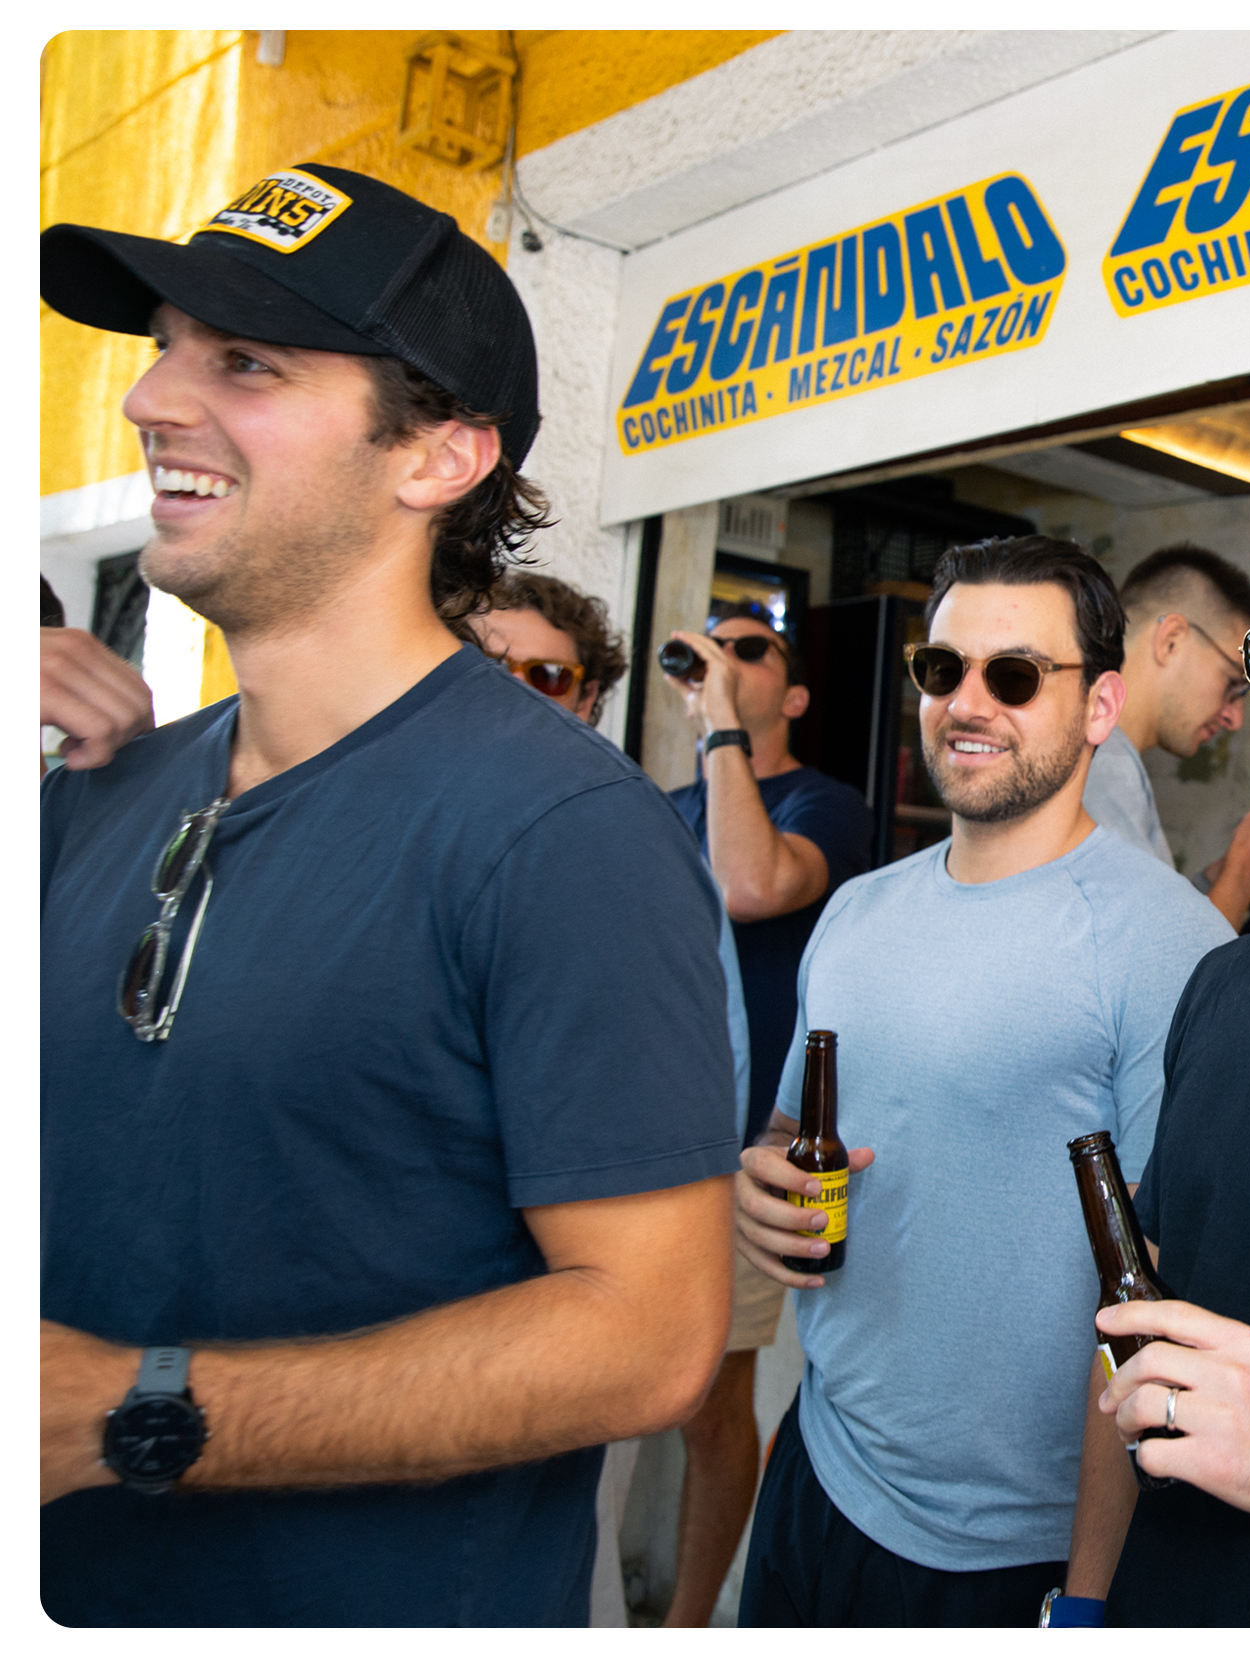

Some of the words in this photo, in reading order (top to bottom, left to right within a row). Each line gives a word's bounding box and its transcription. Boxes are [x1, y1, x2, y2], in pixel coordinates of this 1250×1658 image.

[282, 178, 334, 203] DEPOT
[624, 382, 757, 448] COCHINITA
[788, 336, 902, 403] MEZCAL
[931, 291, 1052, 364] SAZÓN
